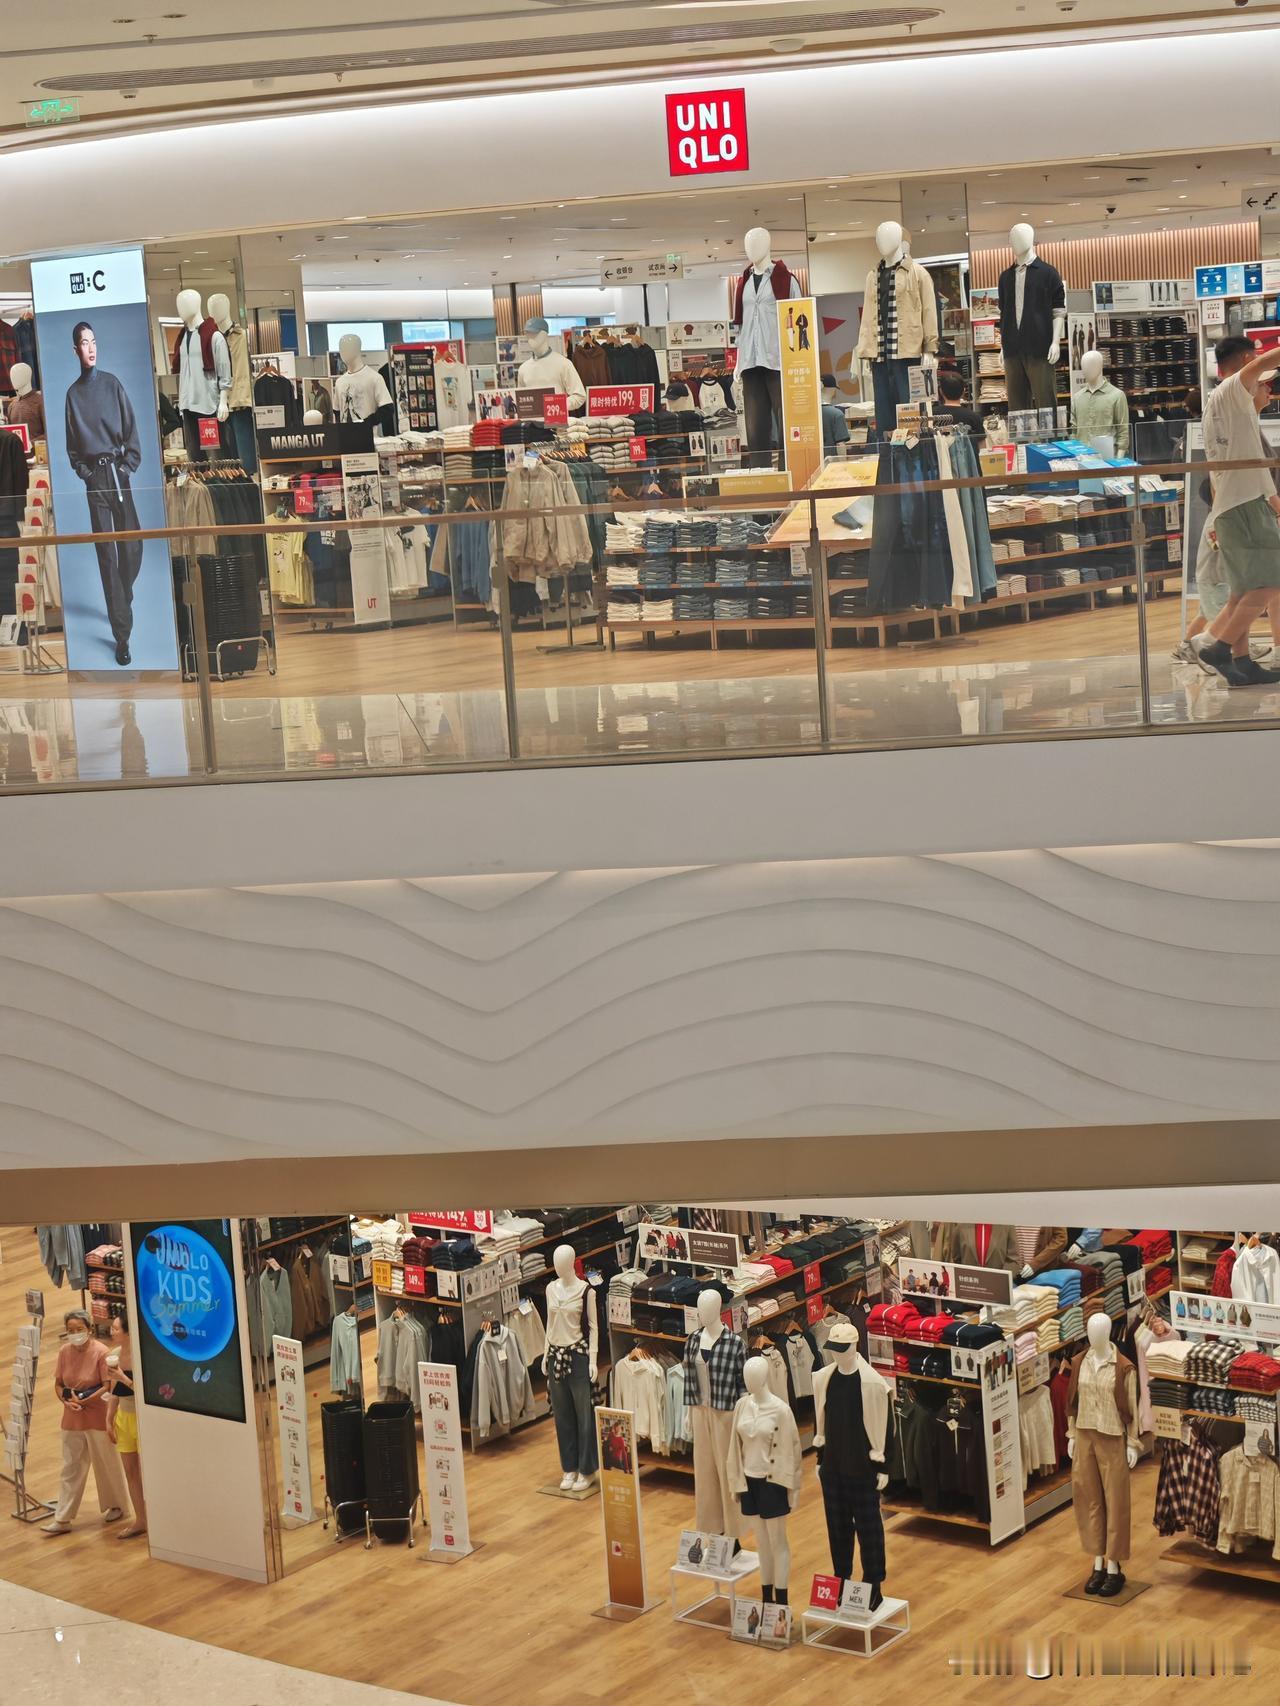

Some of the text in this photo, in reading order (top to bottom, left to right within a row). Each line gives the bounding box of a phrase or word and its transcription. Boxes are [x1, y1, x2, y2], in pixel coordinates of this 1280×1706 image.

[676, 101, 731, 132] UNI
[678, 134, 738, 169] QLO
[71, 275, 83, 283] UNI
[72, 283, 84, 292] QLO
[270, 433, 325, 450] MANGA UT
[367, 598, 377, 609] UT
[157, 1270, 212, 1304] KIDS
[817, 1586, 831, 1600] 129
[852, 1586, 862, 1595] 2F
[849, 1595, 863, 1604] MEN
